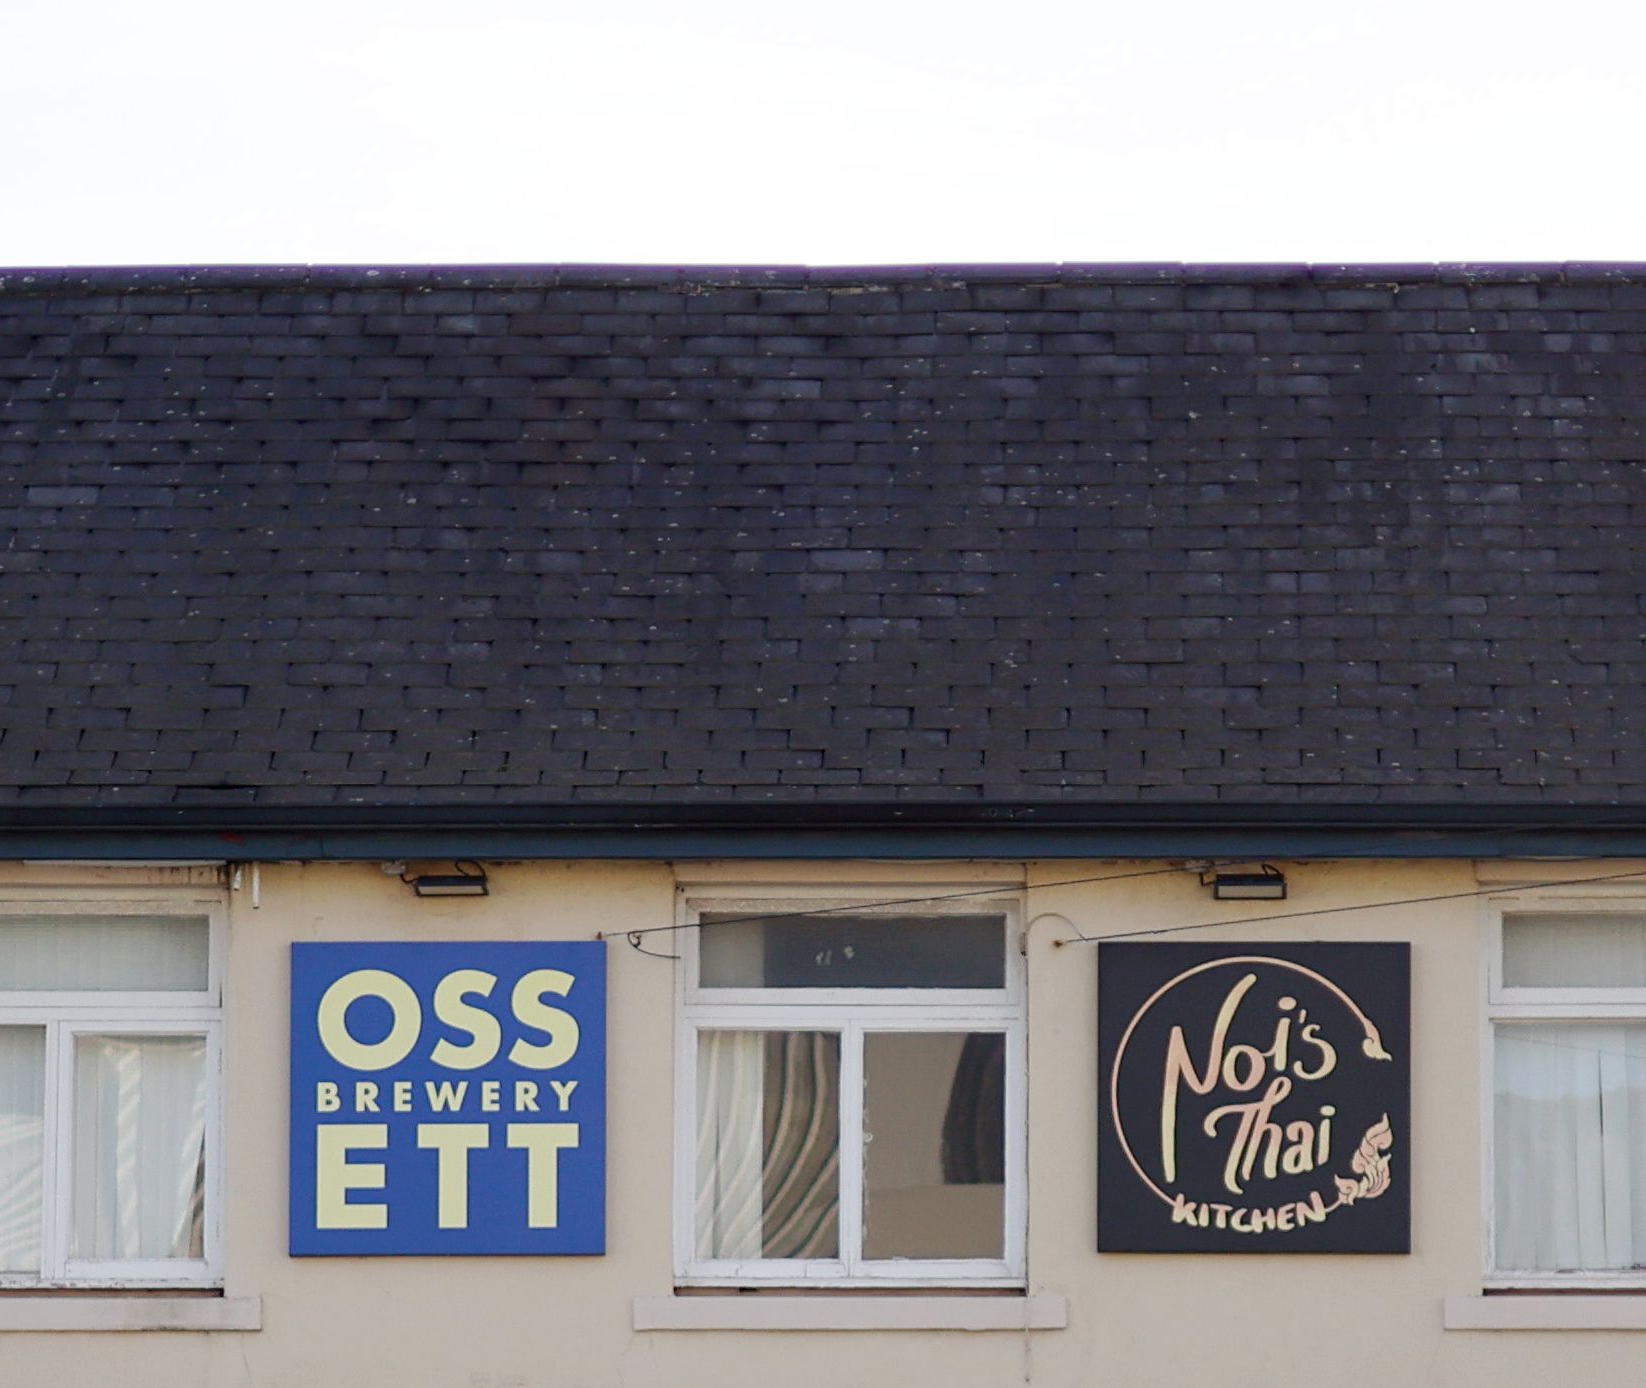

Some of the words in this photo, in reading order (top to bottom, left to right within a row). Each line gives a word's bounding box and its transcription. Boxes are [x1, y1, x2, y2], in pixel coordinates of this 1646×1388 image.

[316, 967, 581, 1072] OSS
[315, 1080, 580, 1113] BREWERY
[1161, 972, 1337, 1183] Noi's
[315, 1122, 581, 1230] ETT
[1203, 1075, 1337, 1195] Thai
[1171, 1190, 1327, 1233] KITCHEN
